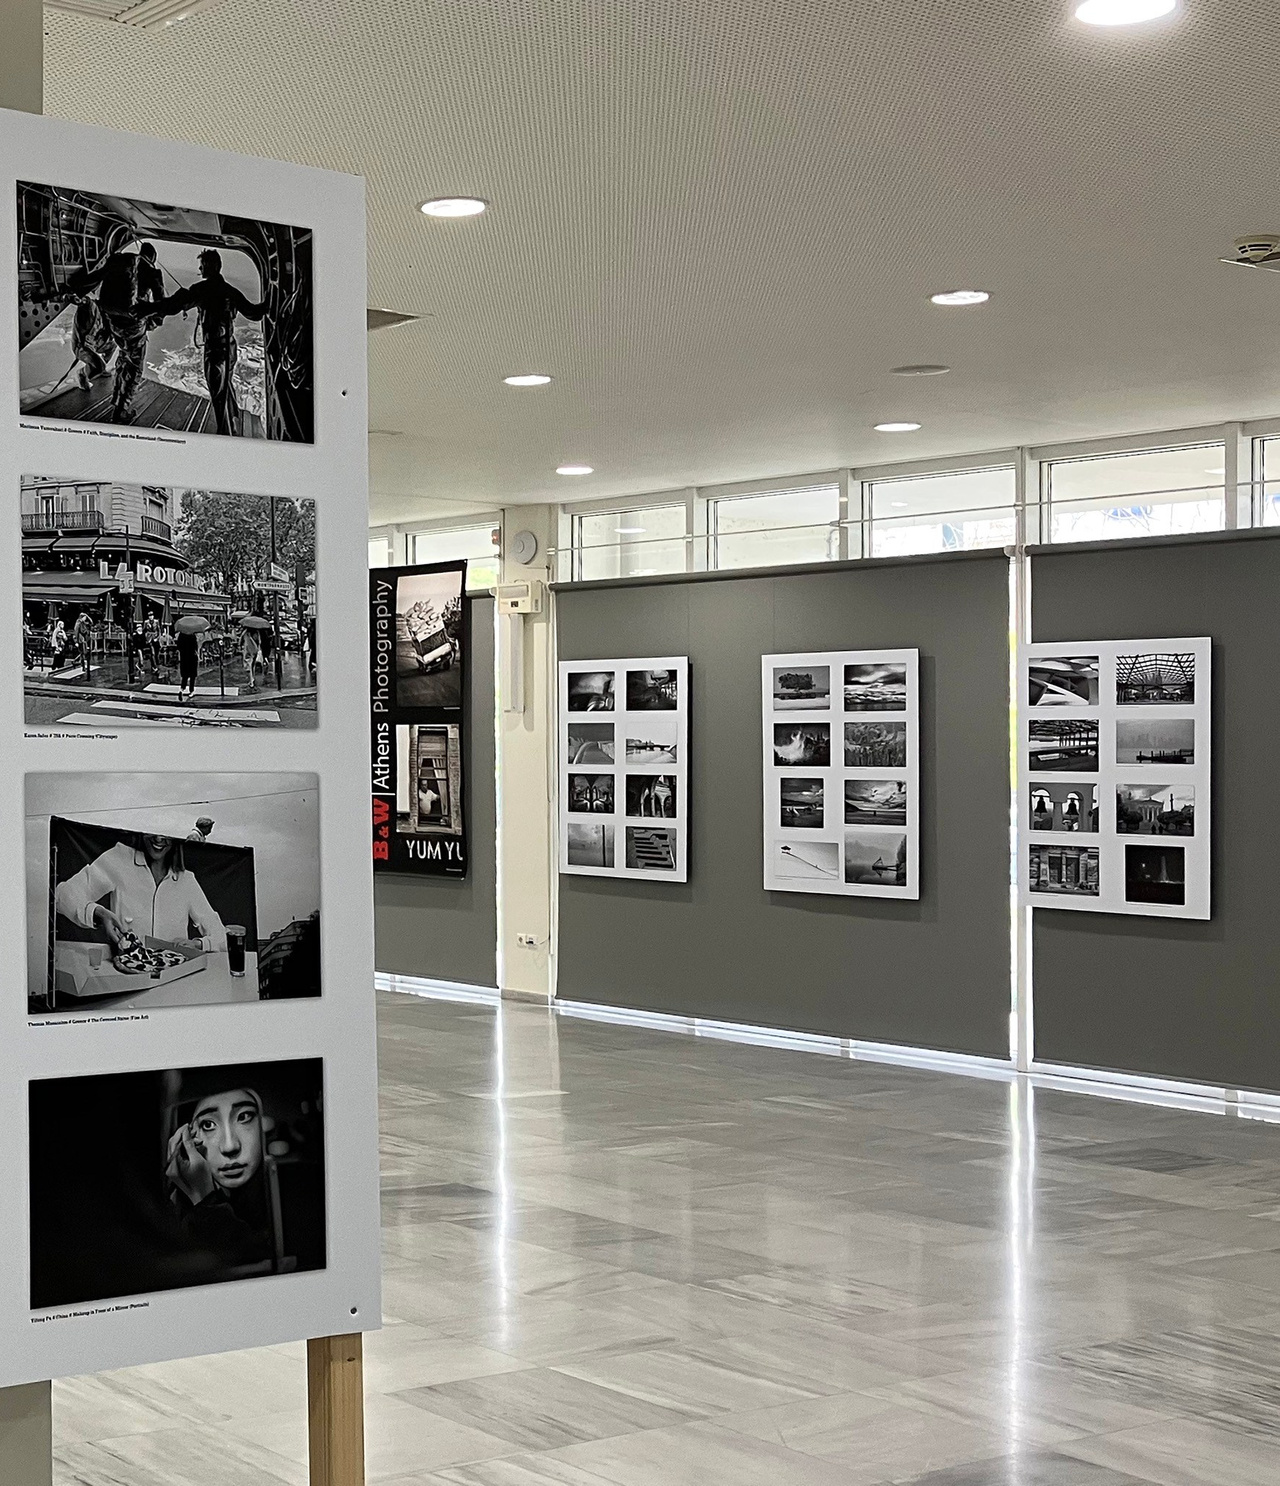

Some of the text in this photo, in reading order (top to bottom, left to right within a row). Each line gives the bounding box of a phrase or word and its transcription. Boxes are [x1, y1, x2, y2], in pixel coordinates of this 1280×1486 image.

[372, 580, 393, 713] Photography
[372, 722, 390, 789] Athens
[406, 839, 442, 860] YUM
